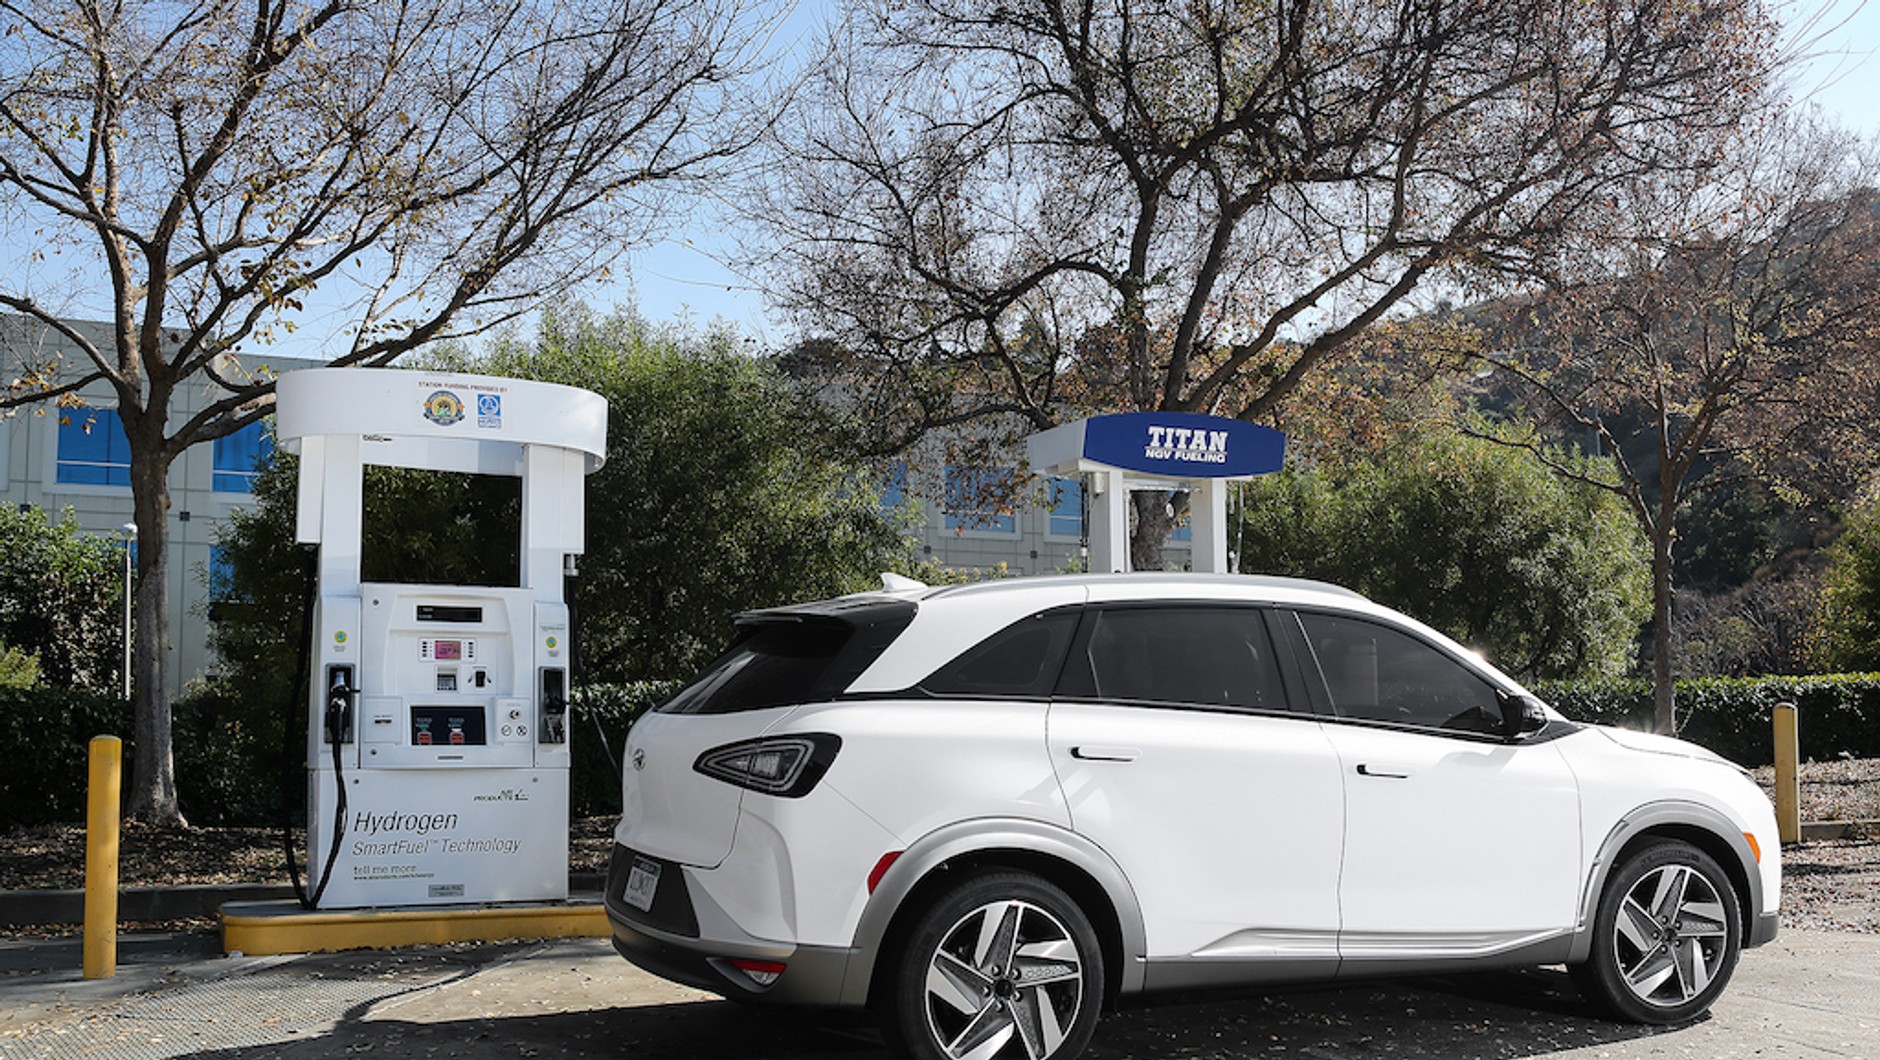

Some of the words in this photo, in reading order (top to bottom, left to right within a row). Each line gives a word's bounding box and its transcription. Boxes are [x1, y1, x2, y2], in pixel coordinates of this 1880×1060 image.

[1148, 426, 1228, 452] TITAN
[1145, 449, 1171, 460] NGV
[1174, 451, 1226, 463] FUELING
[354, 810, 458, 836] Hydrogen
[441, 838, 521, 854] Technology
[354, 866, 370, 875] tell
[372, 866, 388, 874] me
[391, 865, 417, 873] more
